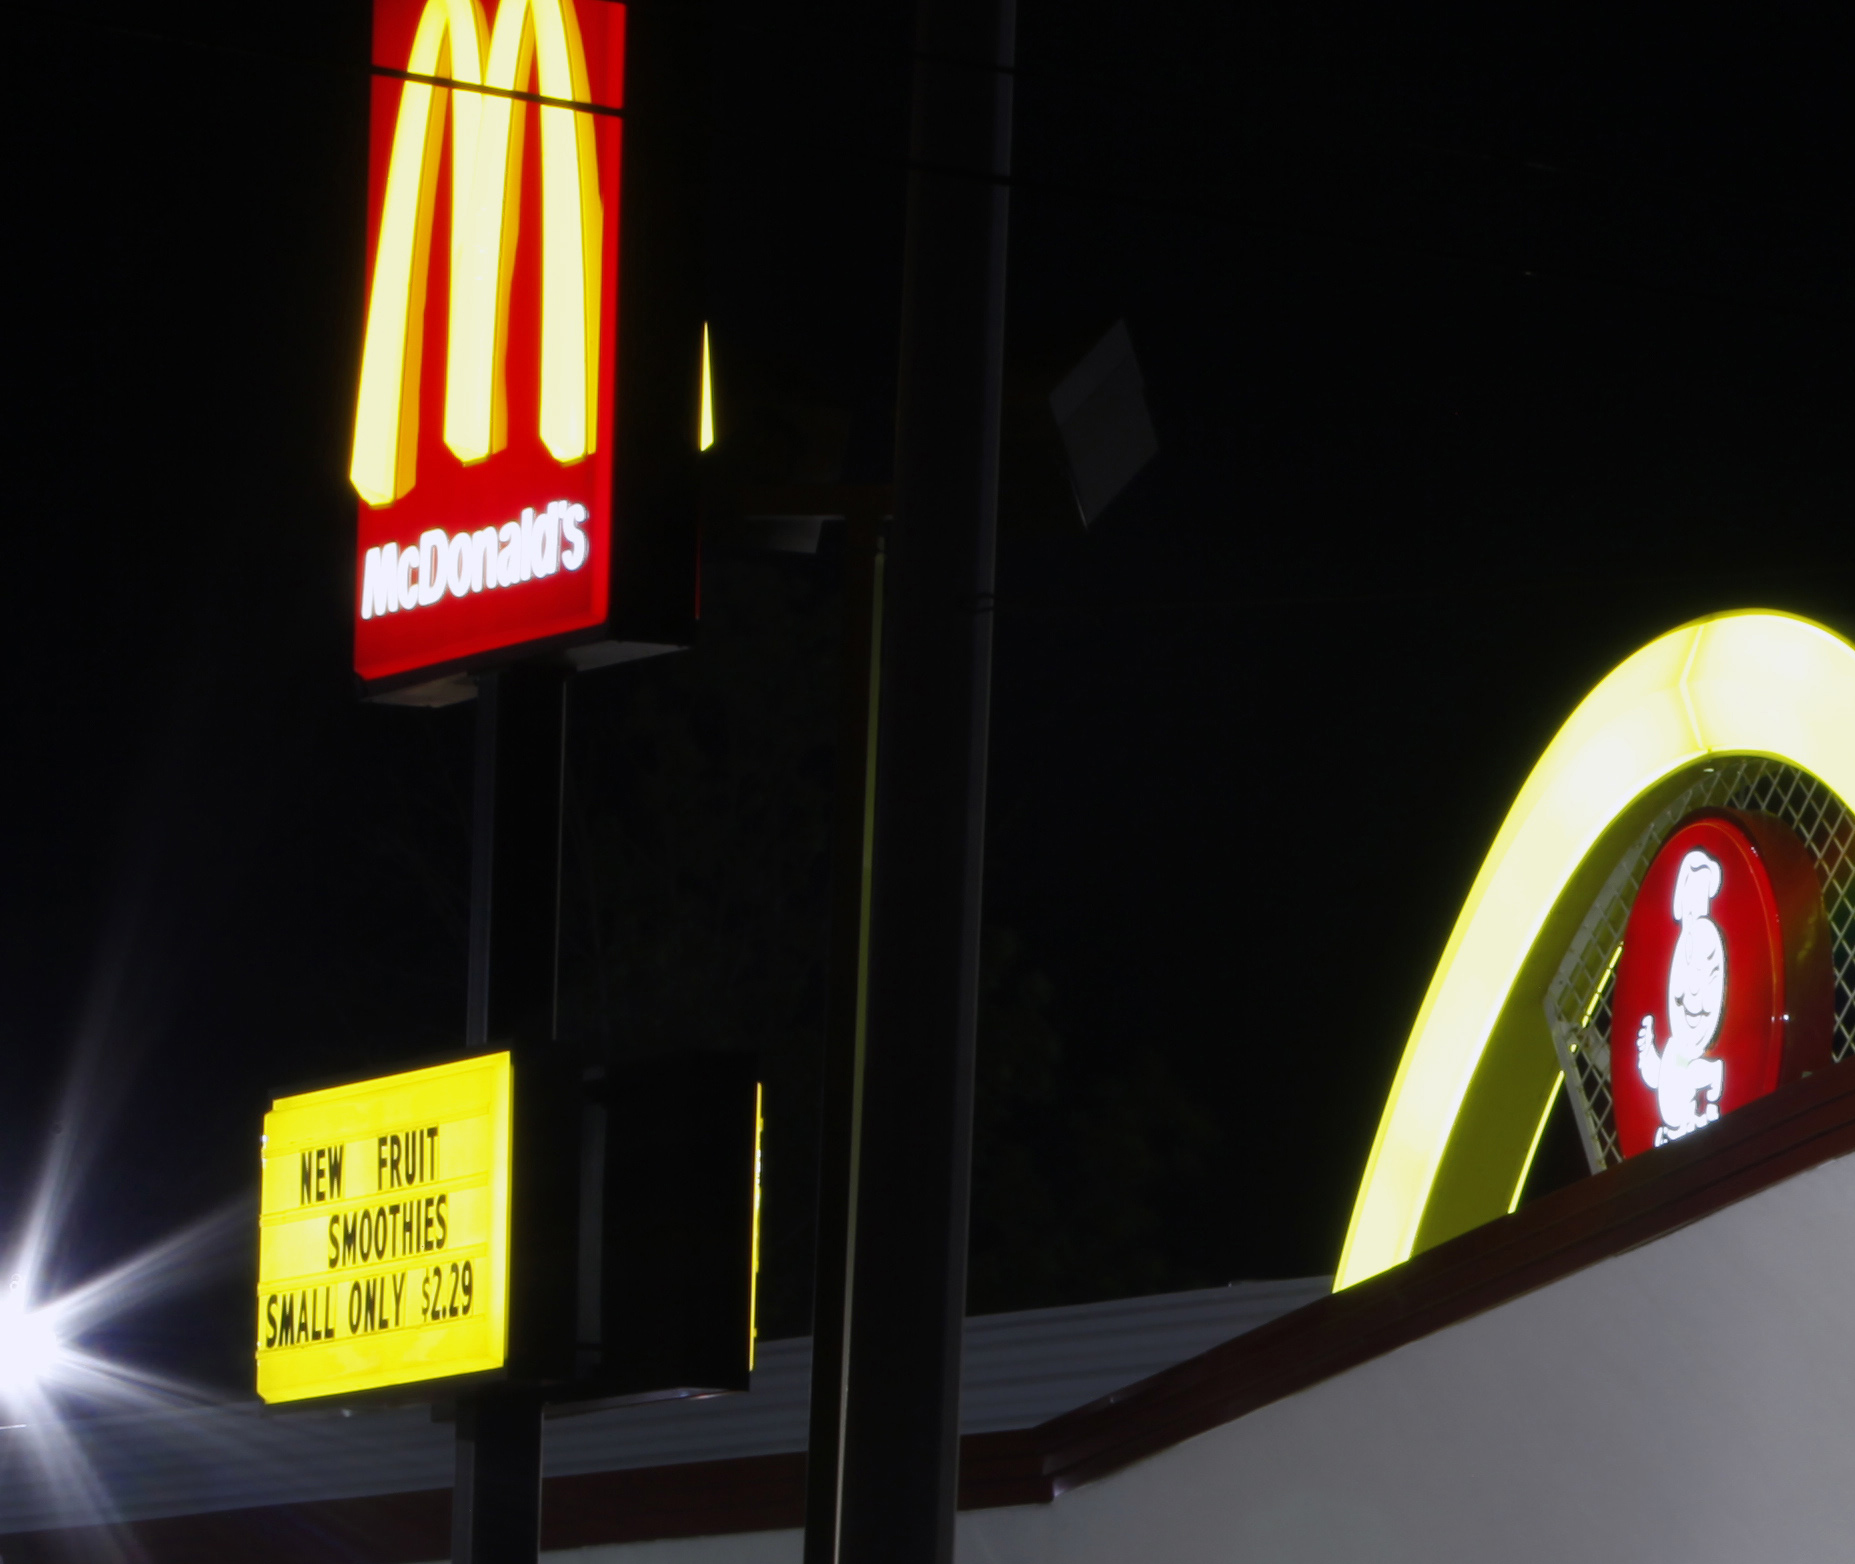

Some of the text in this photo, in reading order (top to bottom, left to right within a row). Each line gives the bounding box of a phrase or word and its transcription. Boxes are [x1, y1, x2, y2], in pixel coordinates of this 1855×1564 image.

[360, 498, 590, 621] McDonald's
[300, 1126, 440, 1206] NEW FRUIT
[327, 1193, 448, 1270] SMOOTHIES
[265, 1261, 474, 1349] SMALL ONLY $2.29
